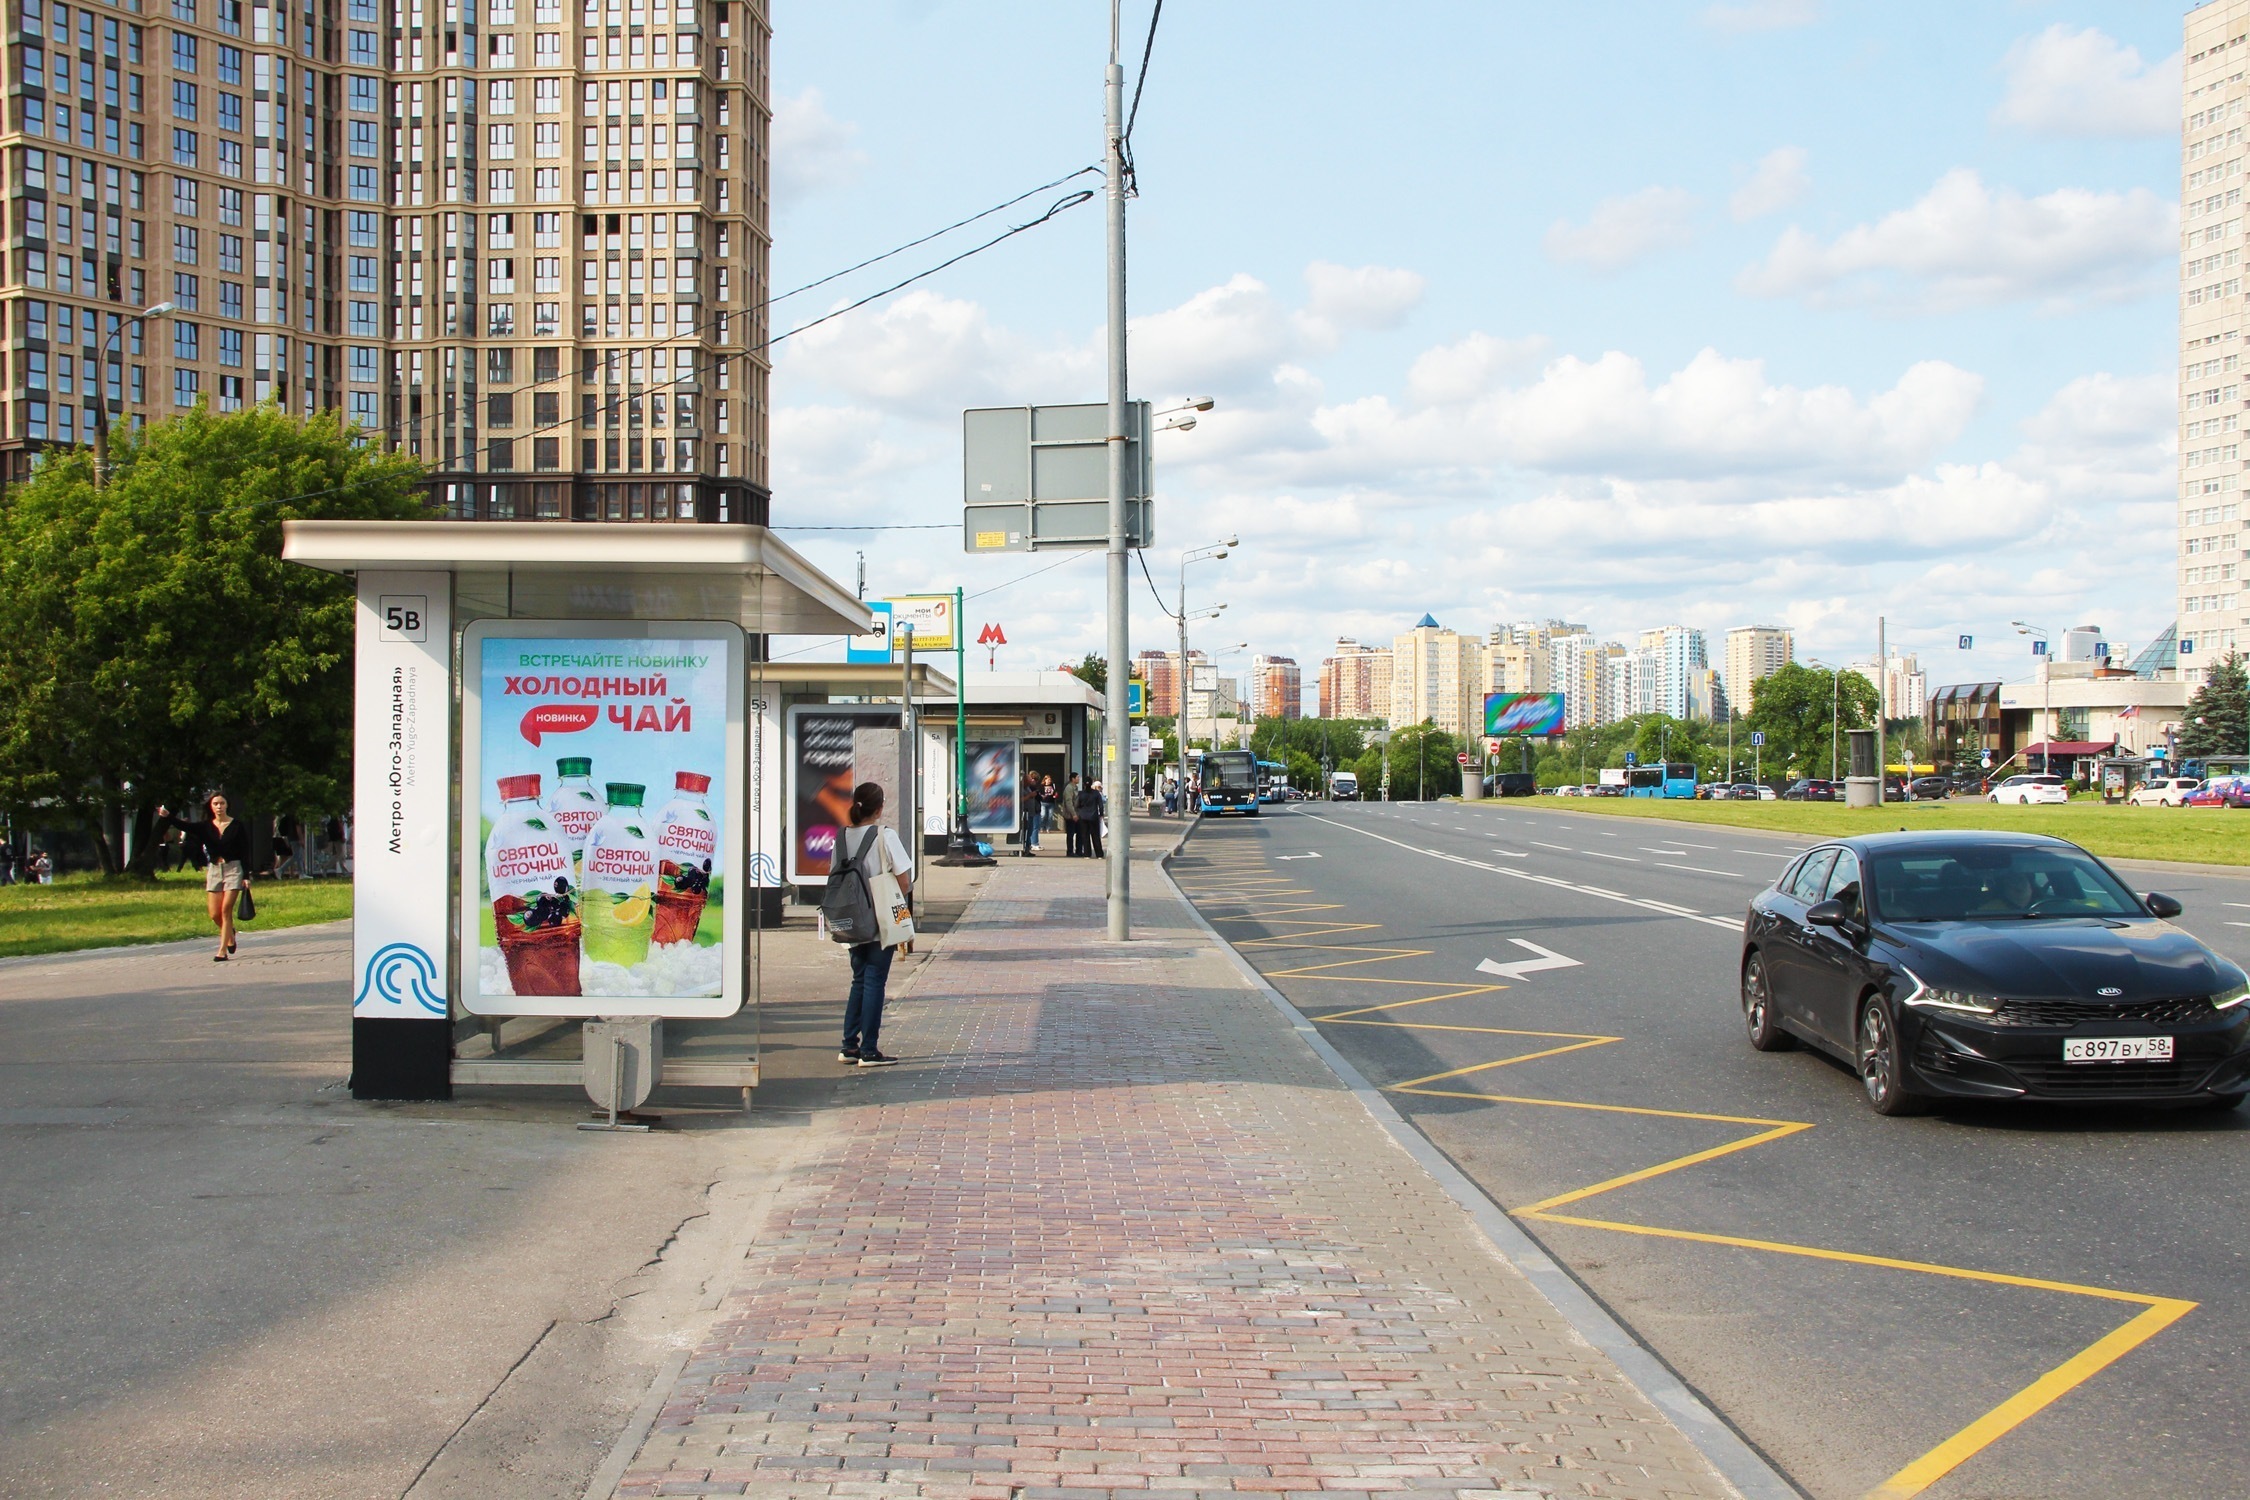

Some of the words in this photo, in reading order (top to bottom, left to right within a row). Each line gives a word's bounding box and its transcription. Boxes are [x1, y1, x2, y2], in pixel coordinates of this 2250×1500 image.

[387, 607, 421, 631] 5В
[519, 652, 623, 667] ВСТРЕЧАЙТЕ
[628, 655, 709, 668] НОВИНКУ
[503, 672, 667, 698] ХОЛОДНЫЙ
[406, 666, 418, 751] Yugo-Zapadnaya
[535, 713, 586, 723] НОВИНКА
[608, 697, 691, 732] ЧАЙ
[389, 666, 404, 796] «Юго-Западная»
[406, 753, 416, 787] Metro
[389, 800, 404, 855] Метро
[658, 835, 716, 853] ИСТОЧНИК
[492, 857, 567, 878] ИСТОЧНИК
[589, 860, 655, 875] ИСТОЧНИК
